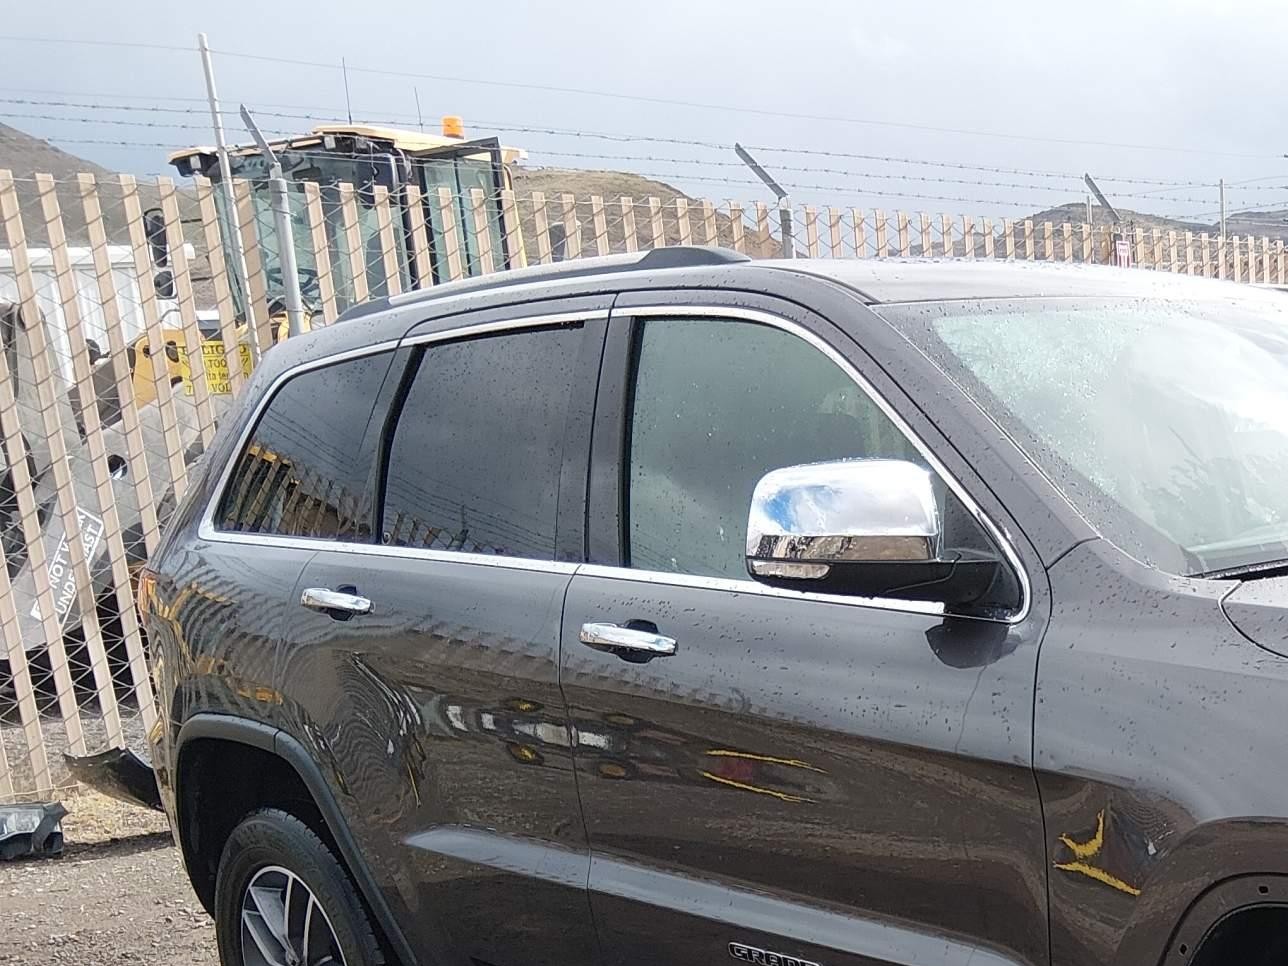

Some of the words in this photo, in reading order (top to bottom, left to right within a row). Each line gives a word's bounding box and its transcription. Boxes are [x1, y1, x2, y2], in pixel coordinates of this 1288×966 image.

[49, 553, 68, 589] NOT
[55, 569, 77, 614] UNDE
[82, 523, 98, 562] AST
